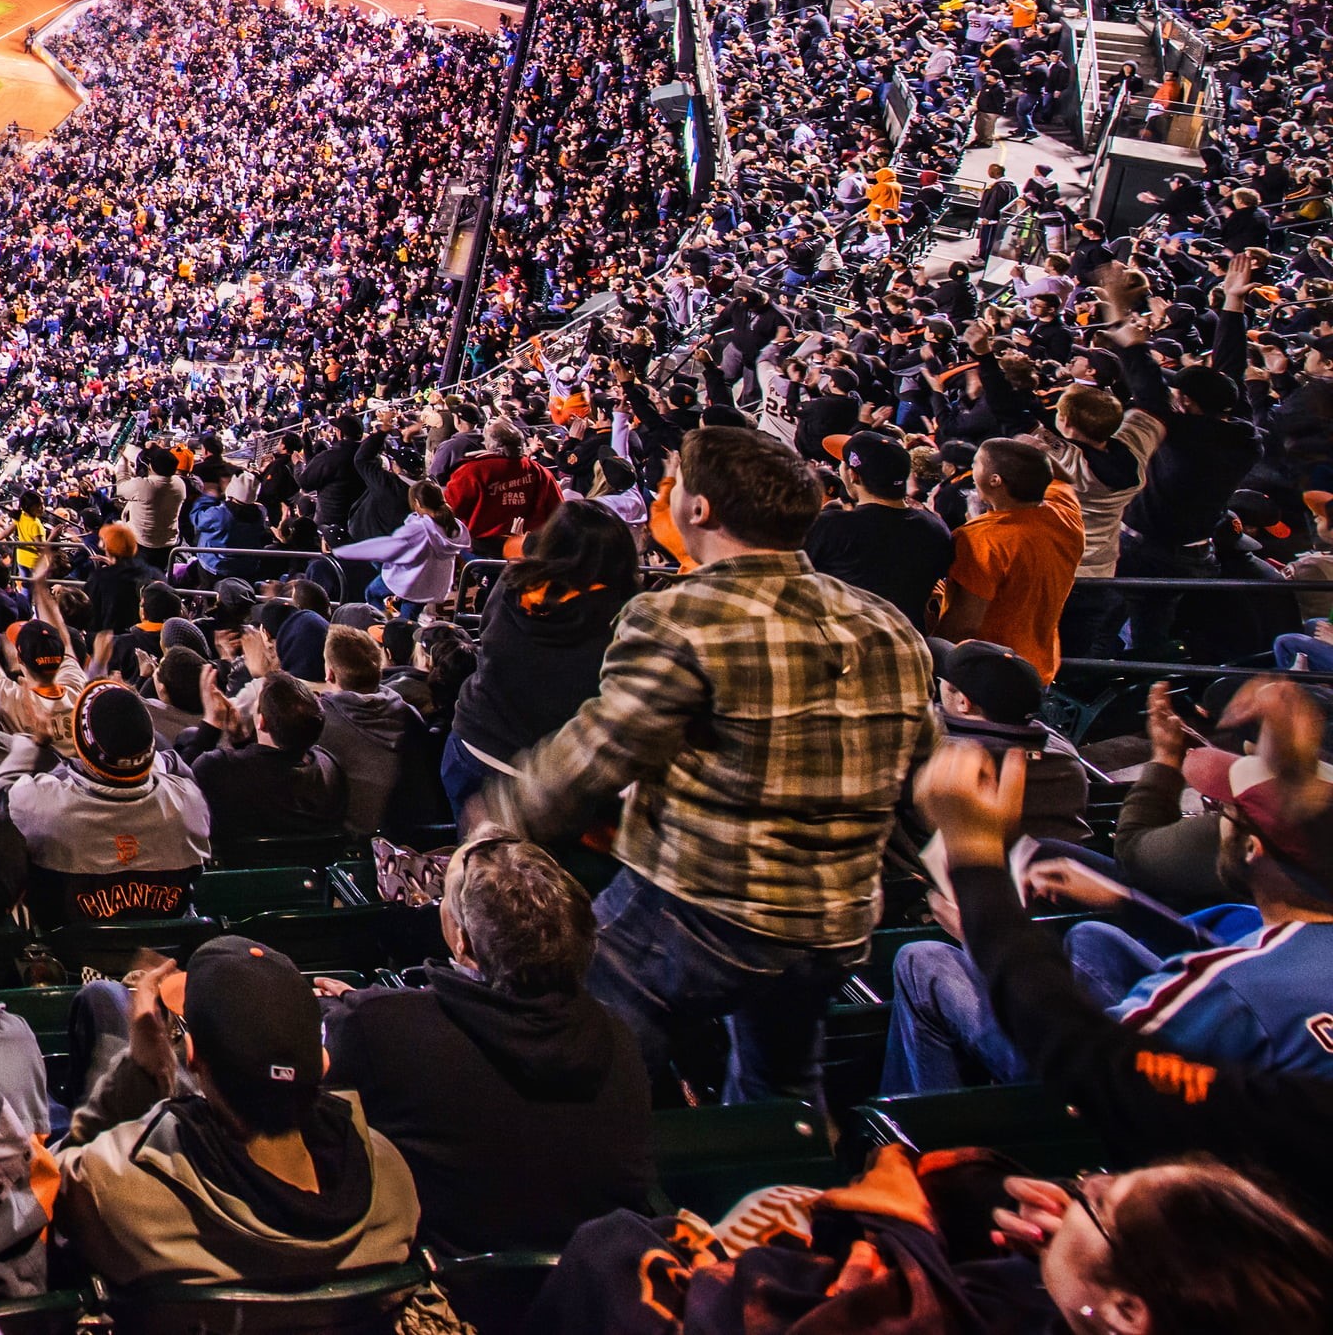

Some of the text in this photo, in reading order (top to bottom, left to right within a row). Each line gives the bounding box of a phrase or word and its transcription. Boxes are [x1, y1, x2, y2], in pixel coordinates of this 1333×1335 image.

[764, 396, 796, 424] 28
[115, 835, 138, 864] SF
[78, 882, 183, 918] GIANTS
